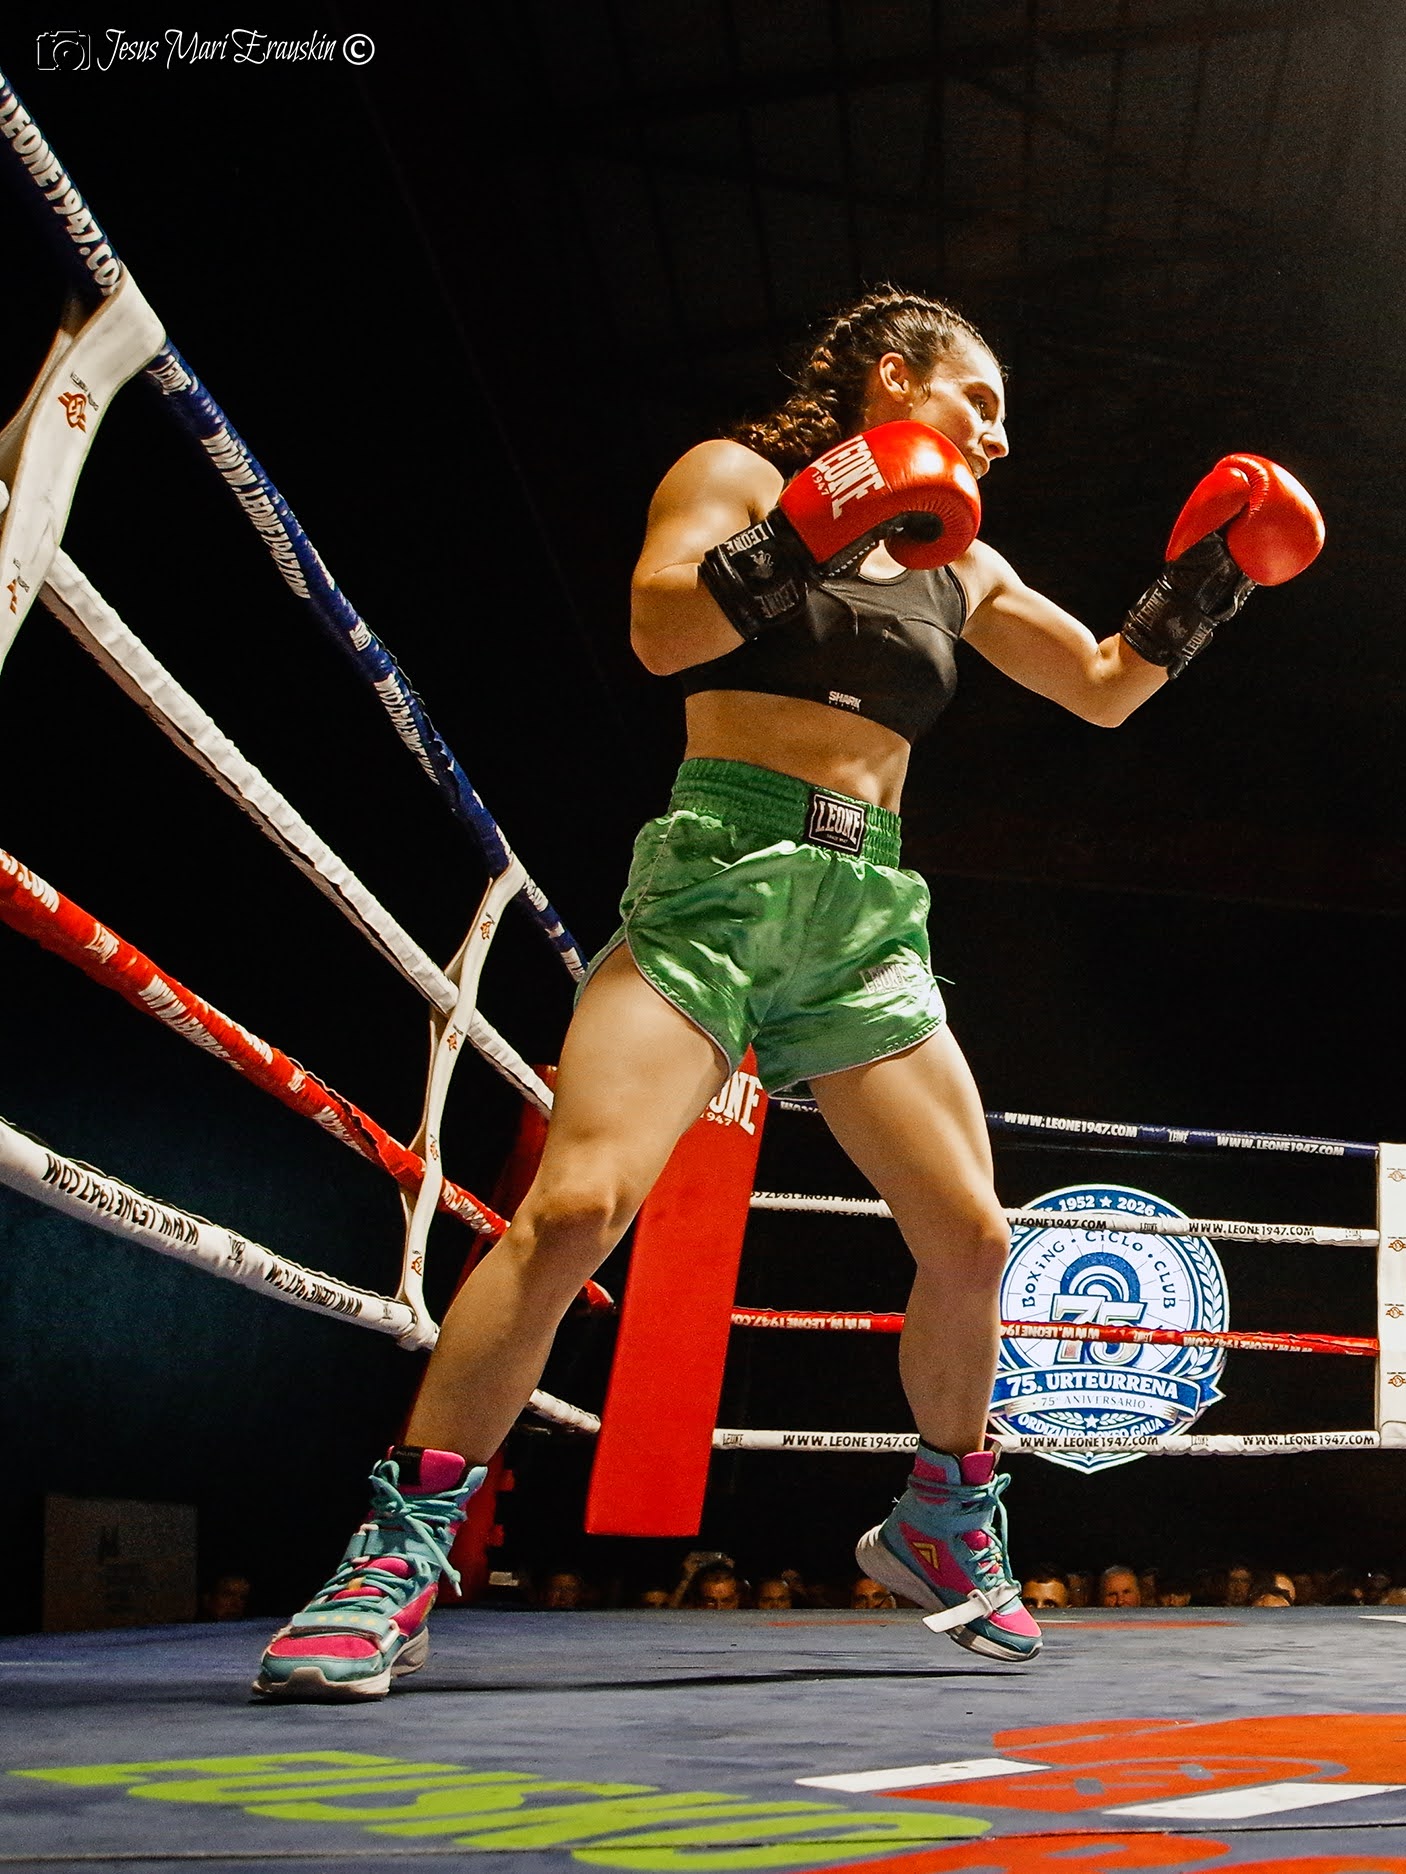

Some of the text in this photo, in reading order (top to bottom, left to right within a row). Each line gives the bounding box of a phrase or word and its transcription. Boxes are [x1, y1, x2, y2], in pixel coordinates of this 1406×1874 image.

[809, 435, 886, 521] LEONE
[811, 471, 830, 496] 1947
[722, 524, 769, 556] LEONE
[828, 690, 862, 709] SHARK
[815, 800, 861, 845] LEONE
[708, 1070, 764, 1136] ONE
[1005, 1111, 1138, 1138] WWW.LEONE1947.COM
[1216, 1135, 1345, 1157] WWW.LEONE1947.COM
[1058, 1195, 1156, 1217] 1952 2026
[1188, 1222, 1315, 1237] WWW.LEONE1947.COM
[1153, 1259, 1176, 1309] CLUB
[1048, 1292, 1148, 1368] 75
[1006, 1371, 1179, 1400] 75. URTEURRENA
[1065, 1396, 1146, 1410] ANIVERSARIO
[1129, 1417, 1166, 1437] GAUA
[1020, 1435, 1159, 1449] WWW.LEONE1947.COM
[1242, 1434, 1375, 1447] WWW.LEONE1947.COM
